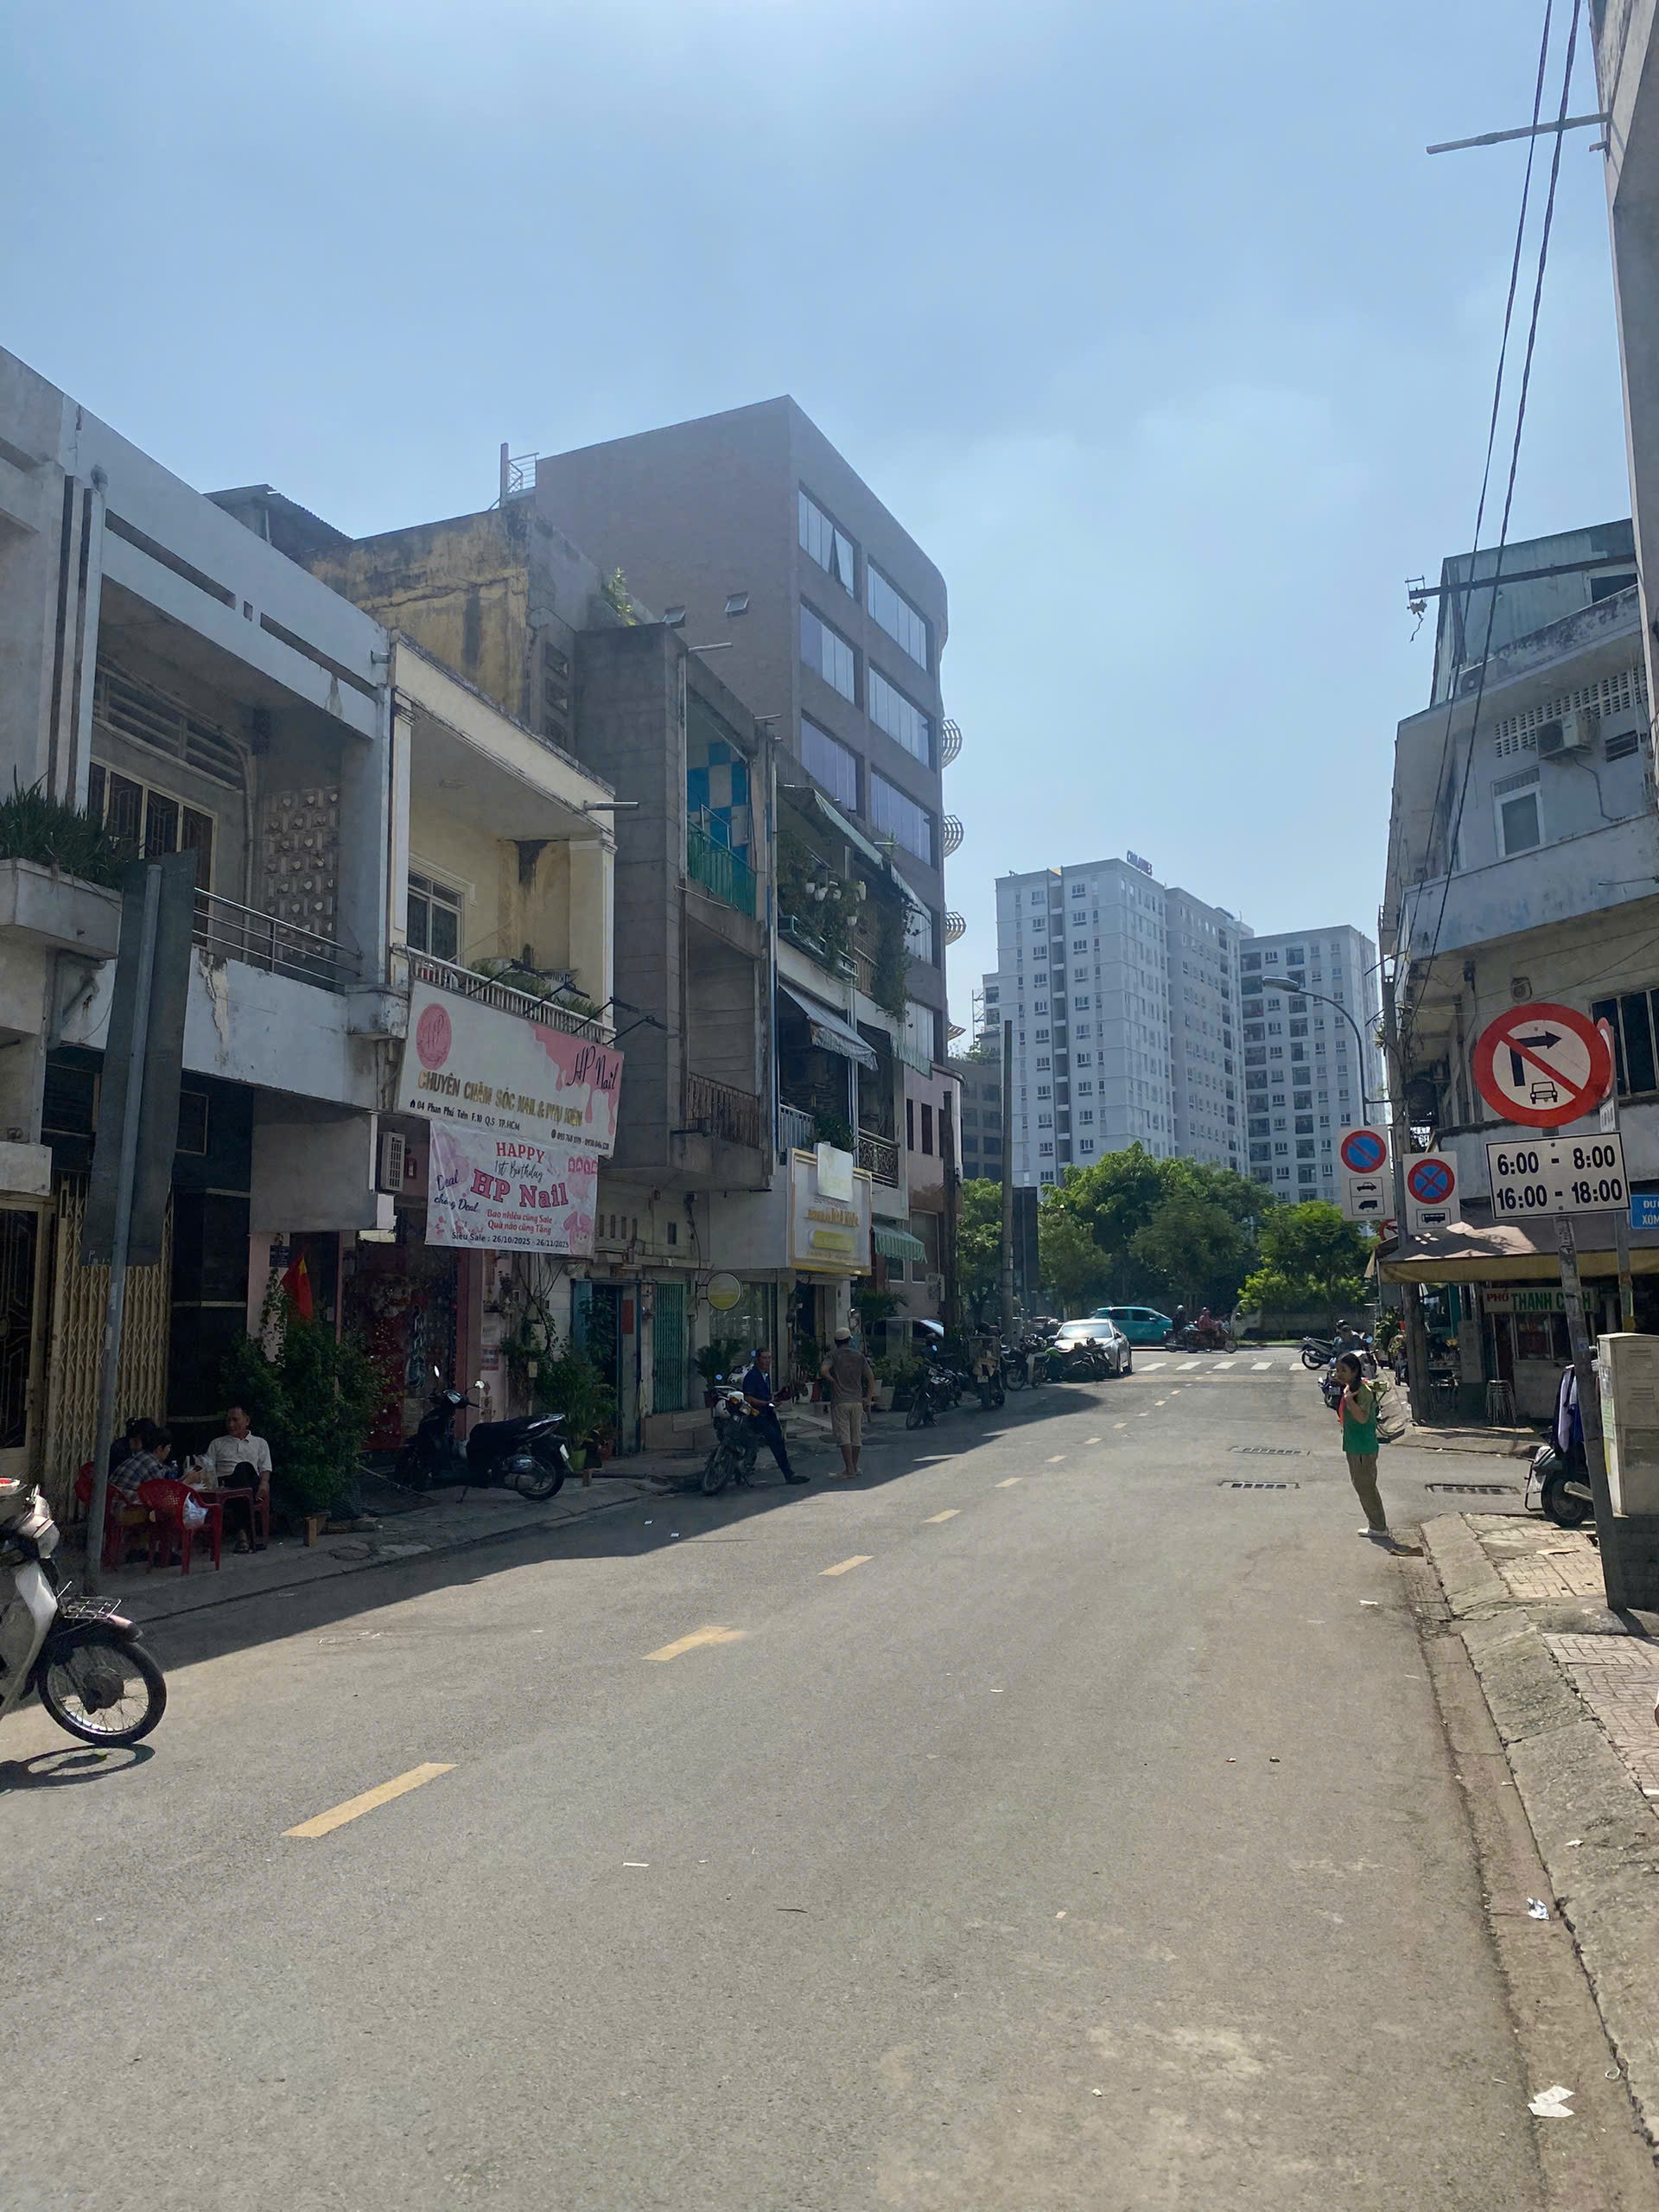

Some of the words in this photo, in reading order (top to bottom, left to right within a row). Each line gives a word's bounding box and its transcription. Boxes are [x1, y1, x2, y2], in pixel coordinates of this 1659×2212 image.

[566, 1046, 596, 1086] HP
[595, 1054, 620, 1090] Nail
[418, 1071, 461, 1097] CHUYÊN
[495, 1087, 516, 1110] SÓC
[416, 1100, 424, 1110] 04
[427, 1103, 442, 1114] Phan
[485, 1116, 496, 1127] Q.5
[499, 1118, 520, 1131] TP.HCM
[496, 1141, 545, 1164] HAPPY
[1497, 1151, 1539, 1176] 6:00
[1573, 1145, 1616, 1170] 8:00
[470, 1168, 511, 1204] HP
[519, 1182, 569, 1209] Nail
[1497, 1185, 1548, 1210] 16:00
[1571, 1179, 1623, 1205] 18:00
[487, 1209, 501, 1218] Bao
[538, 1214, 552, 1224] Sale
[487, 1219, 503, 1230] Quà
[469, 1233, 486, 1243] Sale
[493, 1235, 531, 1245] 26/10/2025
[1510, 1292, 1553, 1311] THANH
[1556, 1292, 1591, 1311] CH
